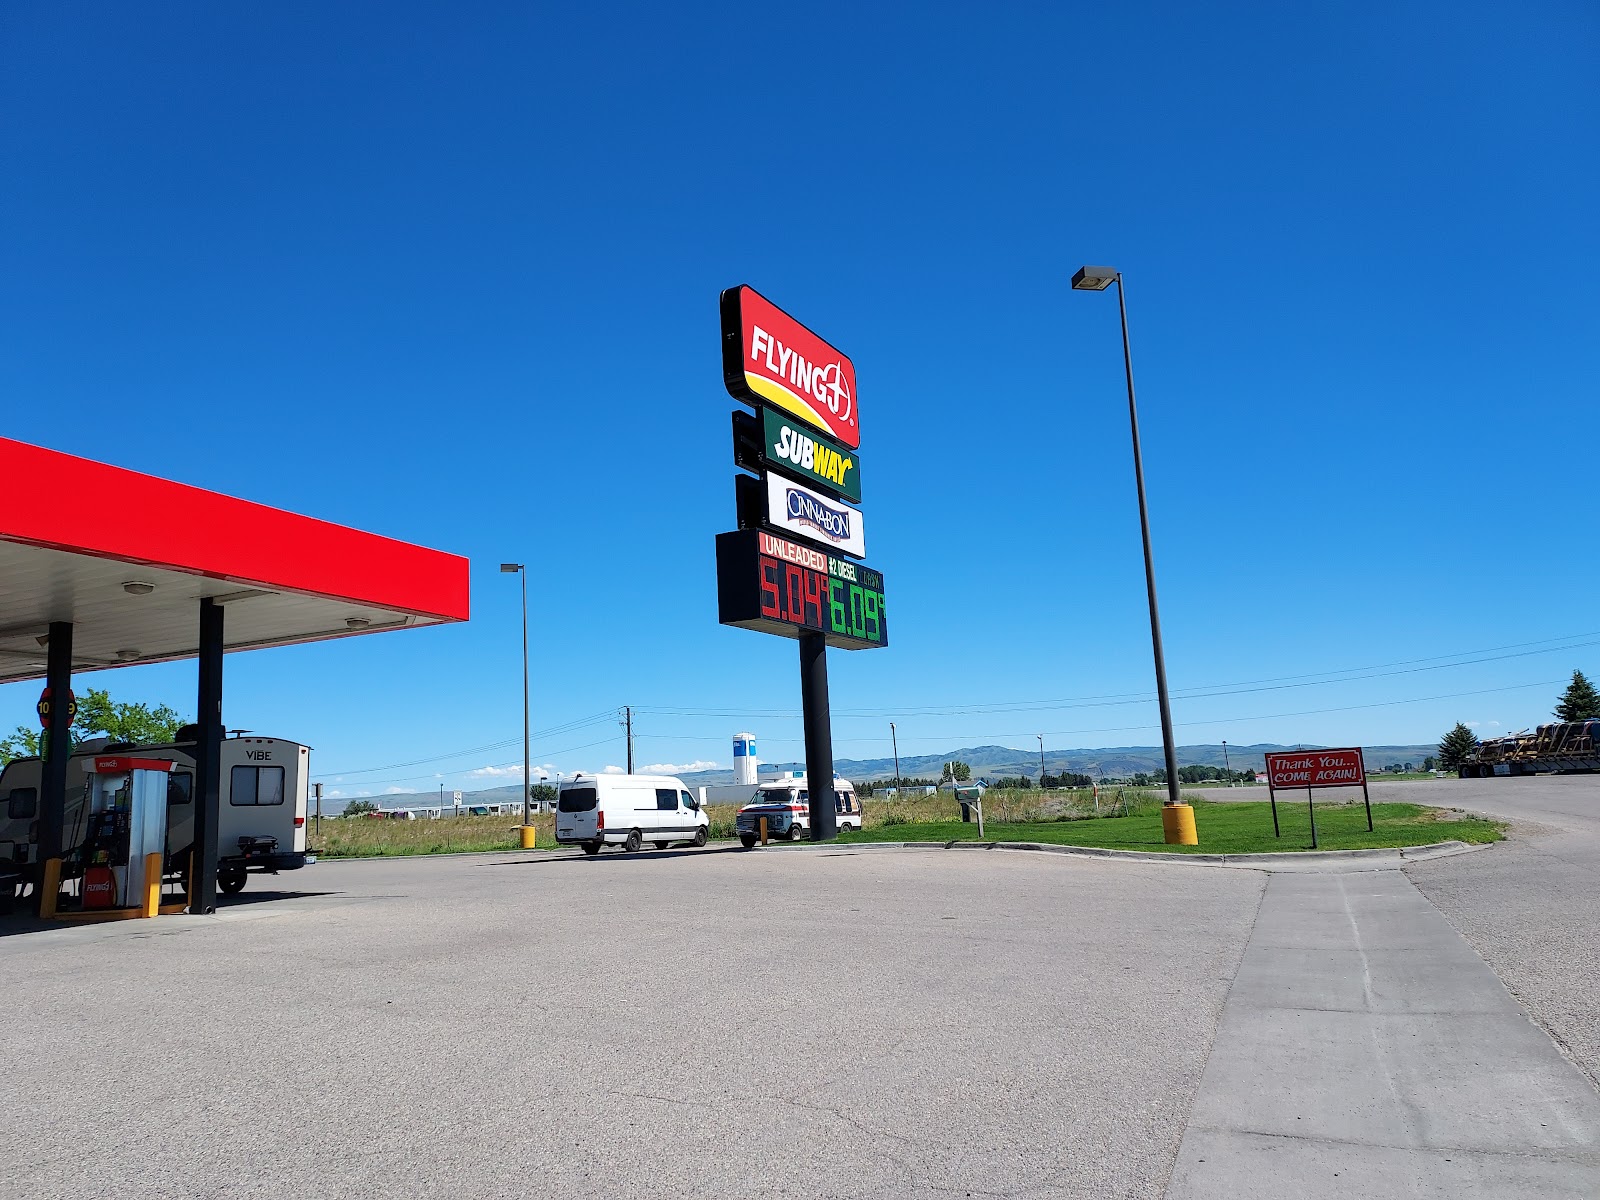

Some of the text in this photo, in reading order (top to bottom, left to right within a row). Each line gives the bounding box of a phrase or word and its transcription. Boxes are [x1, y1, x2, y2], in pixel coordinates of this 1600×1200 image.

[751, 324, 827, 404] FLYING
[773, 425, 853, 486] SUBWAY
[787, 489, 850, 537] CINNABON
[764, 534, 825, 571] UNLEADED
[837, 560, 857, 582] DIESEL
[38, 701, 50, 714] 10
[68, 702, 76, 715] 9
[245, 750, 272, 761] VIBE
[1274, 758, 1316, 770] Thank
[1274, 767, 1358, 783] COME AGAIN!
